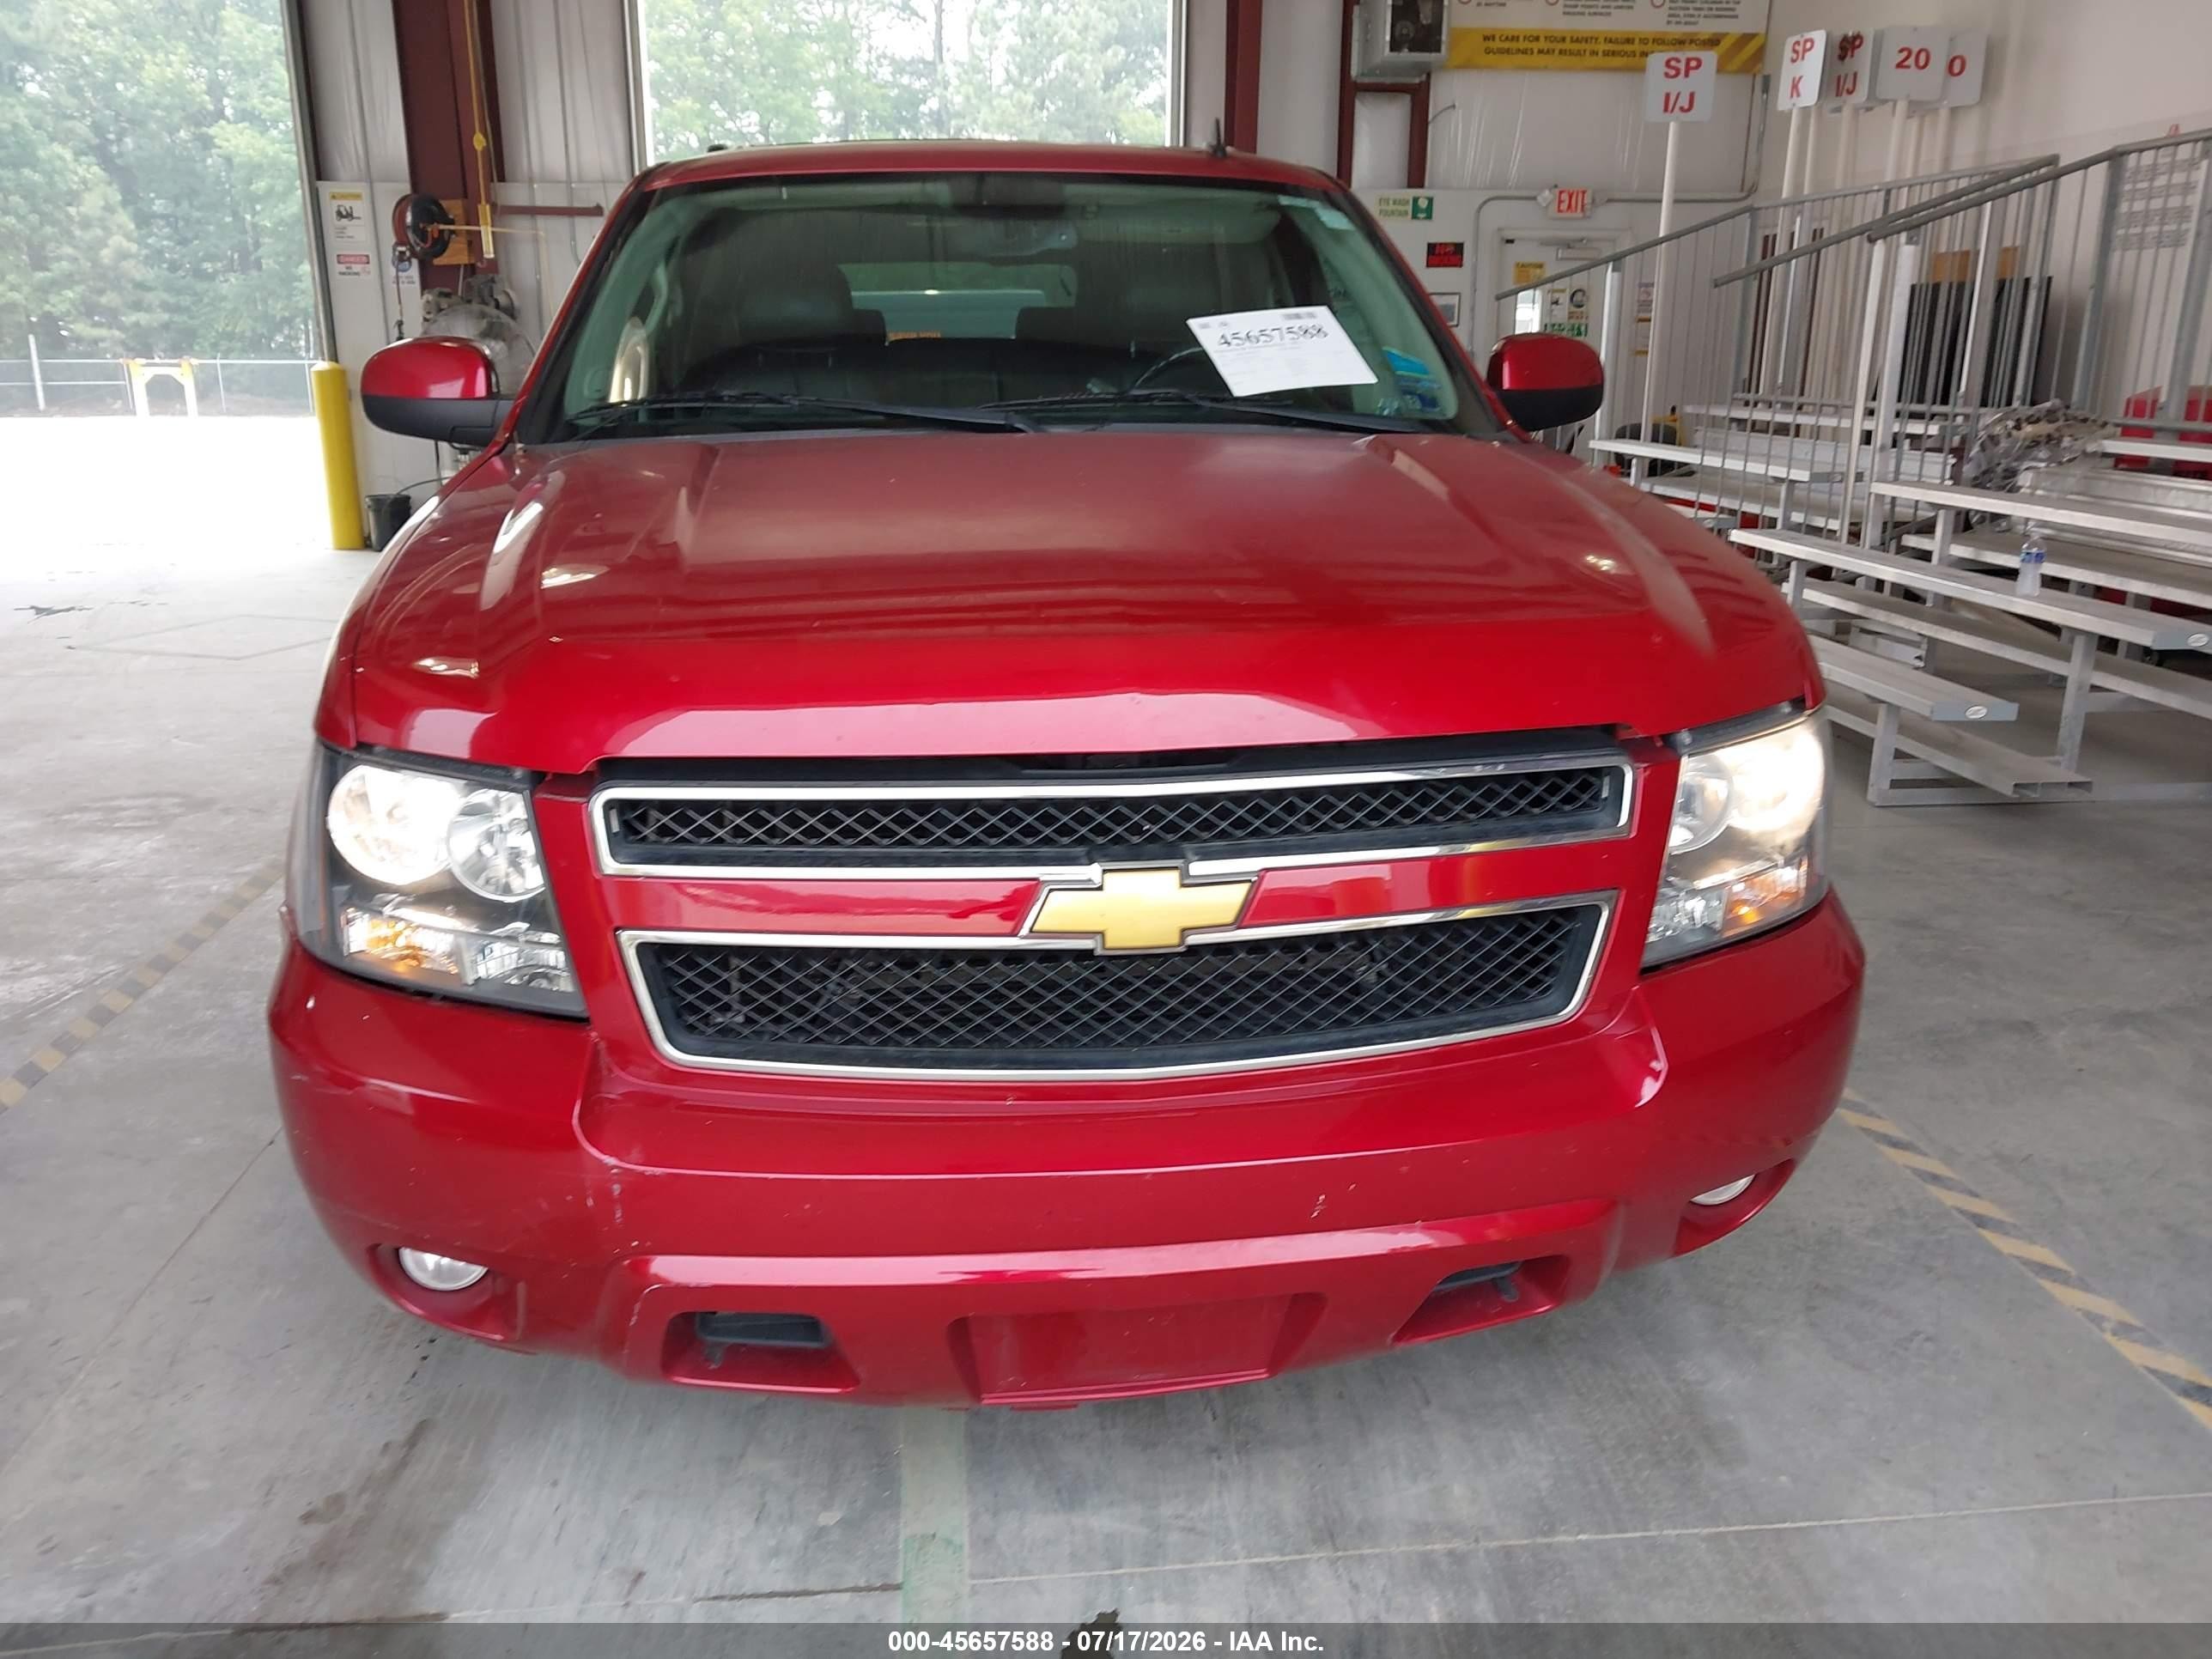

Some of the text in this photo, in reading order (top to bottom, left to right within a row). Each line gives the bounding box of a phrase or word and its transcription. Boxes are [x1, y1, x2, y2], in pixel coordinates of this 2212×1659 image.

[1523, 34, 1540, 43] FOR
[1604, 37, 1635, 46] FAILURE
[1652, 38, 1687, 46] FOLLOW
[1689, 39, 1721, 47] POSTED
[1790, 37, 1814, 64] SP
[1485, 47, 1534, 56] GUIDELINES
[1537, 47, 1555, 56] MAY
[1559, 48, 1586, 57] RESULT
[1601, 49, 1636, 58] SERIOUS
[1895, 46, 1930, 70] 20
[1663, 57, 1703, 79] SP
[1790, 76, 1803, 99] K
[1835, 71, 1857, 97] I/J
[1662, 91, 1695, 113] I/J
[1558, 190, 1588, 214] EXIT
[1218, 324, 1328, 347] 45657588
